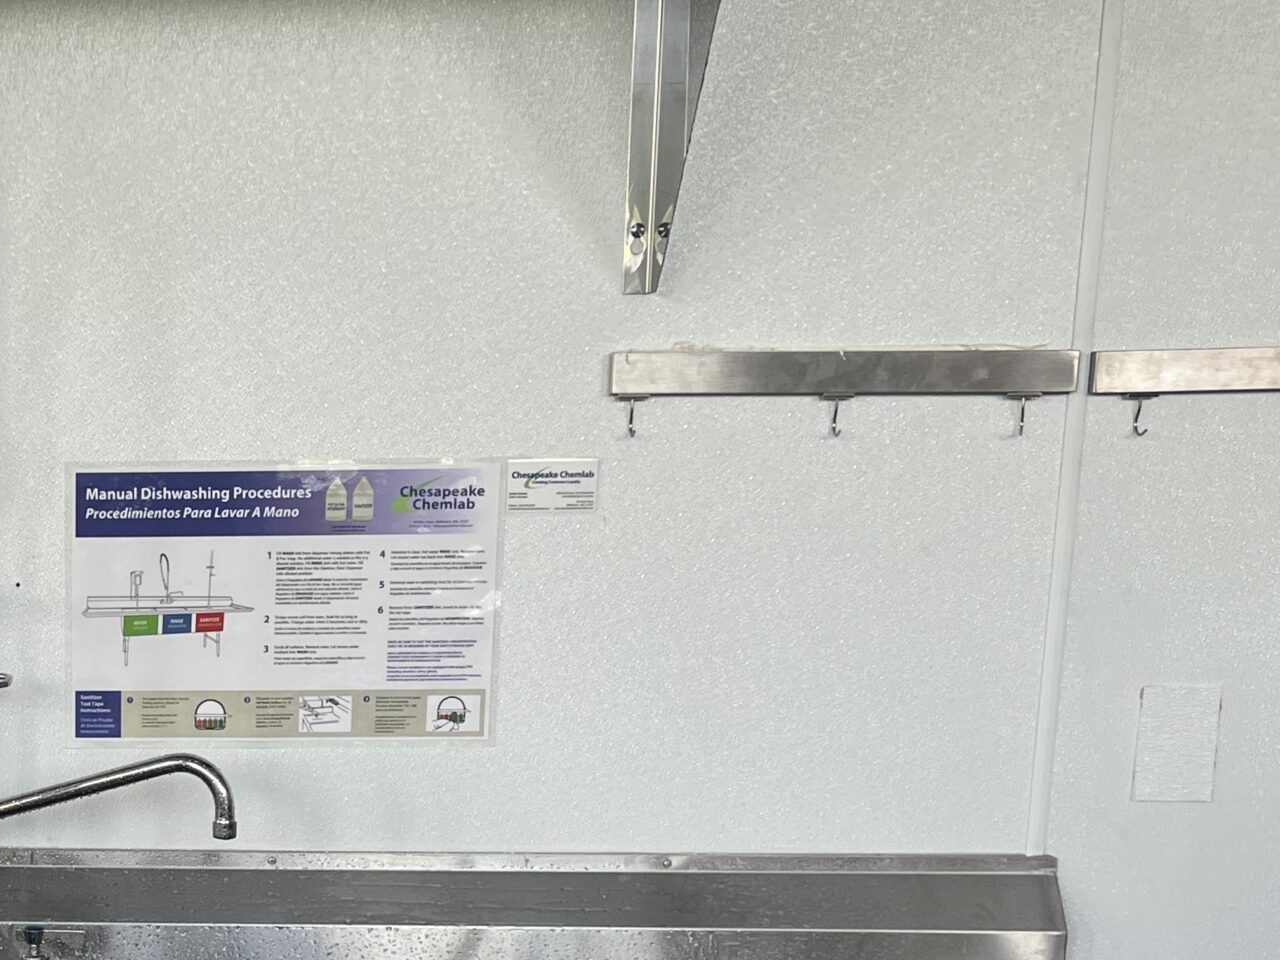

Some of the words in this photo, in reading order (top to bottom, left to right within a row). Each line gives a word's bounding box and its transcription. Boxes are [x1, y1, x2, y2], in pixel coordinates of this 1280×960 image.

[512, 471, 558, 479] Chesapeake
[560, 470, 594, 478] Chemlab
[85, 487, 138, 500] Manual
[141, 486, 230, 502] Dishwashing
[233, 486, 312, 499] Procedures
[400, 485, 486, 500] Chesapeake
[412, 498, 476, 510] Chemlab
[85, 508, 181, 520] Procedimientos
[183, 507, 212, 518] Para
[214, 507, 250, 518] Lavar
[252, 507, 261, 518] A
[263, 506, 300, 518] Mano
[267, 551, 271, 559] 1
[380, 550, 385, 558] 4
[378, 606, 384, 614] 6
[264, 645, 269, 653] 3
